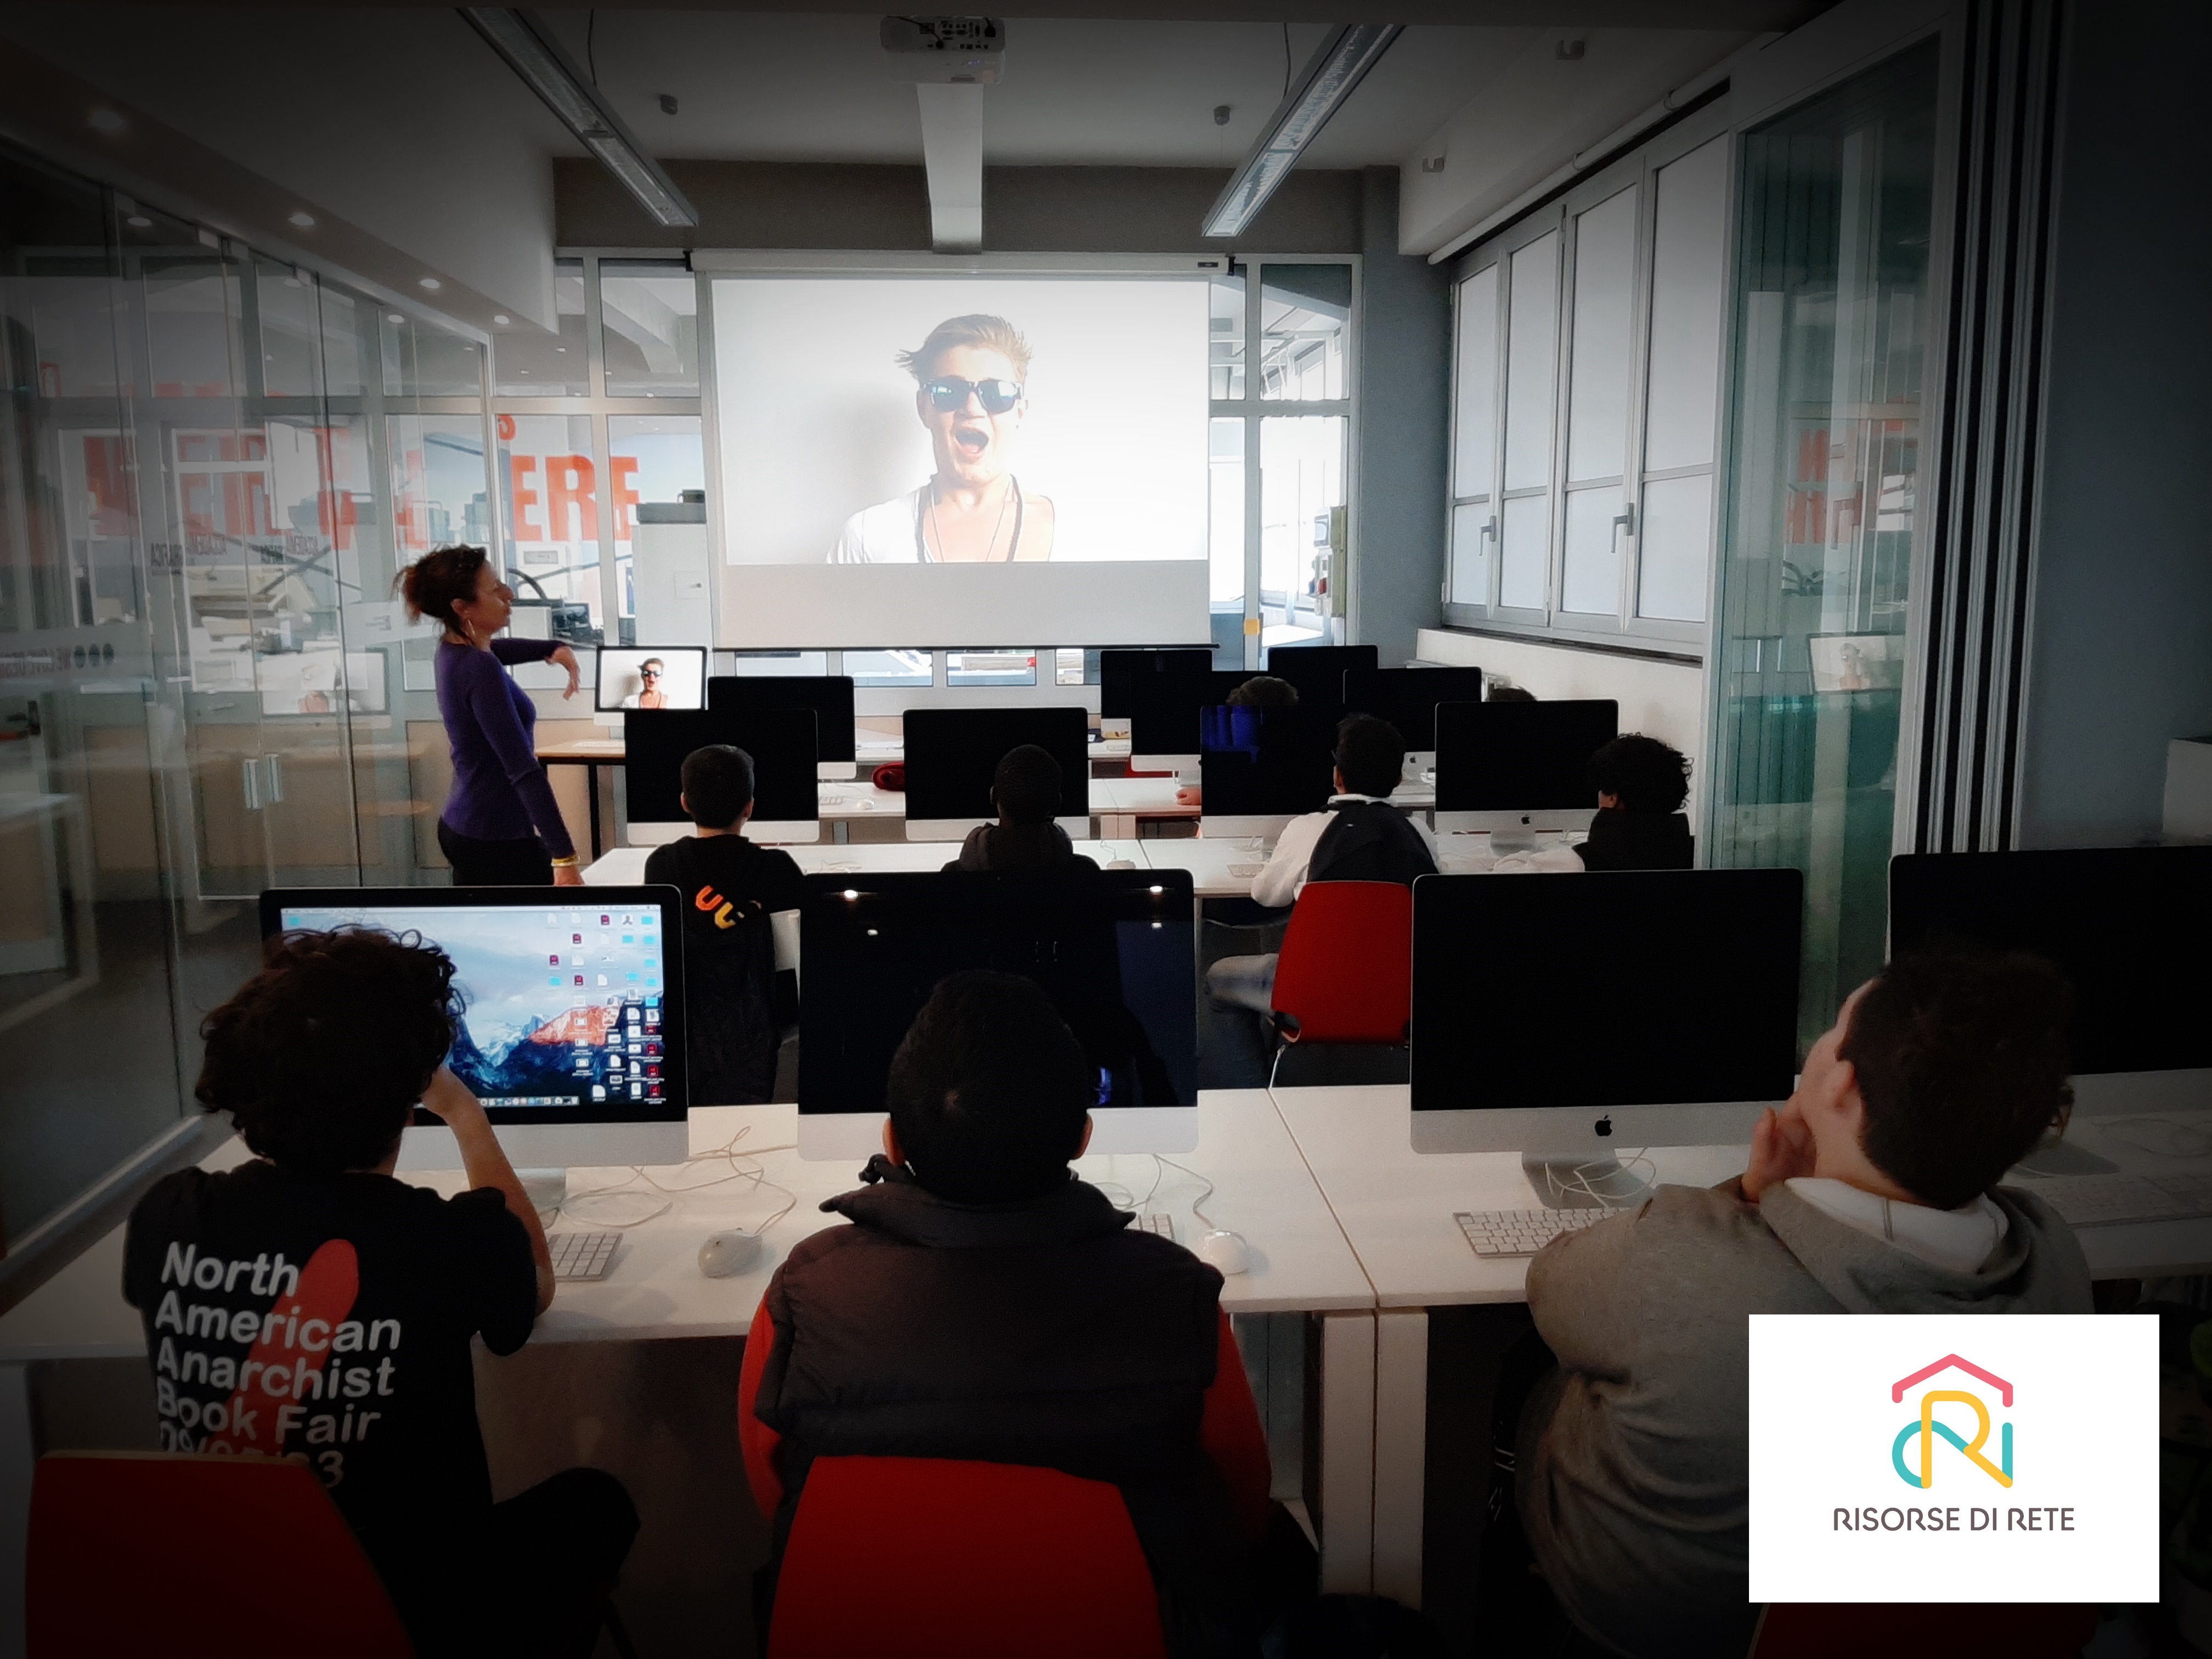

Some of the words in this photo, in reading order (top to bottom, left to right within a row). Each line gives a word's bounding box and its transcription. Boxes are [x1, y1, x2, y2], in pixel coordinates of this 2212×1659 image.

[161, 1241, 300, 1297] North
[155, 1289, 402, 1352] American
[156, 1336, 396, 1400] Anarchist
[156, 1375, 259, 1441] Book
[275, 1403, 382, 1445] Fair
